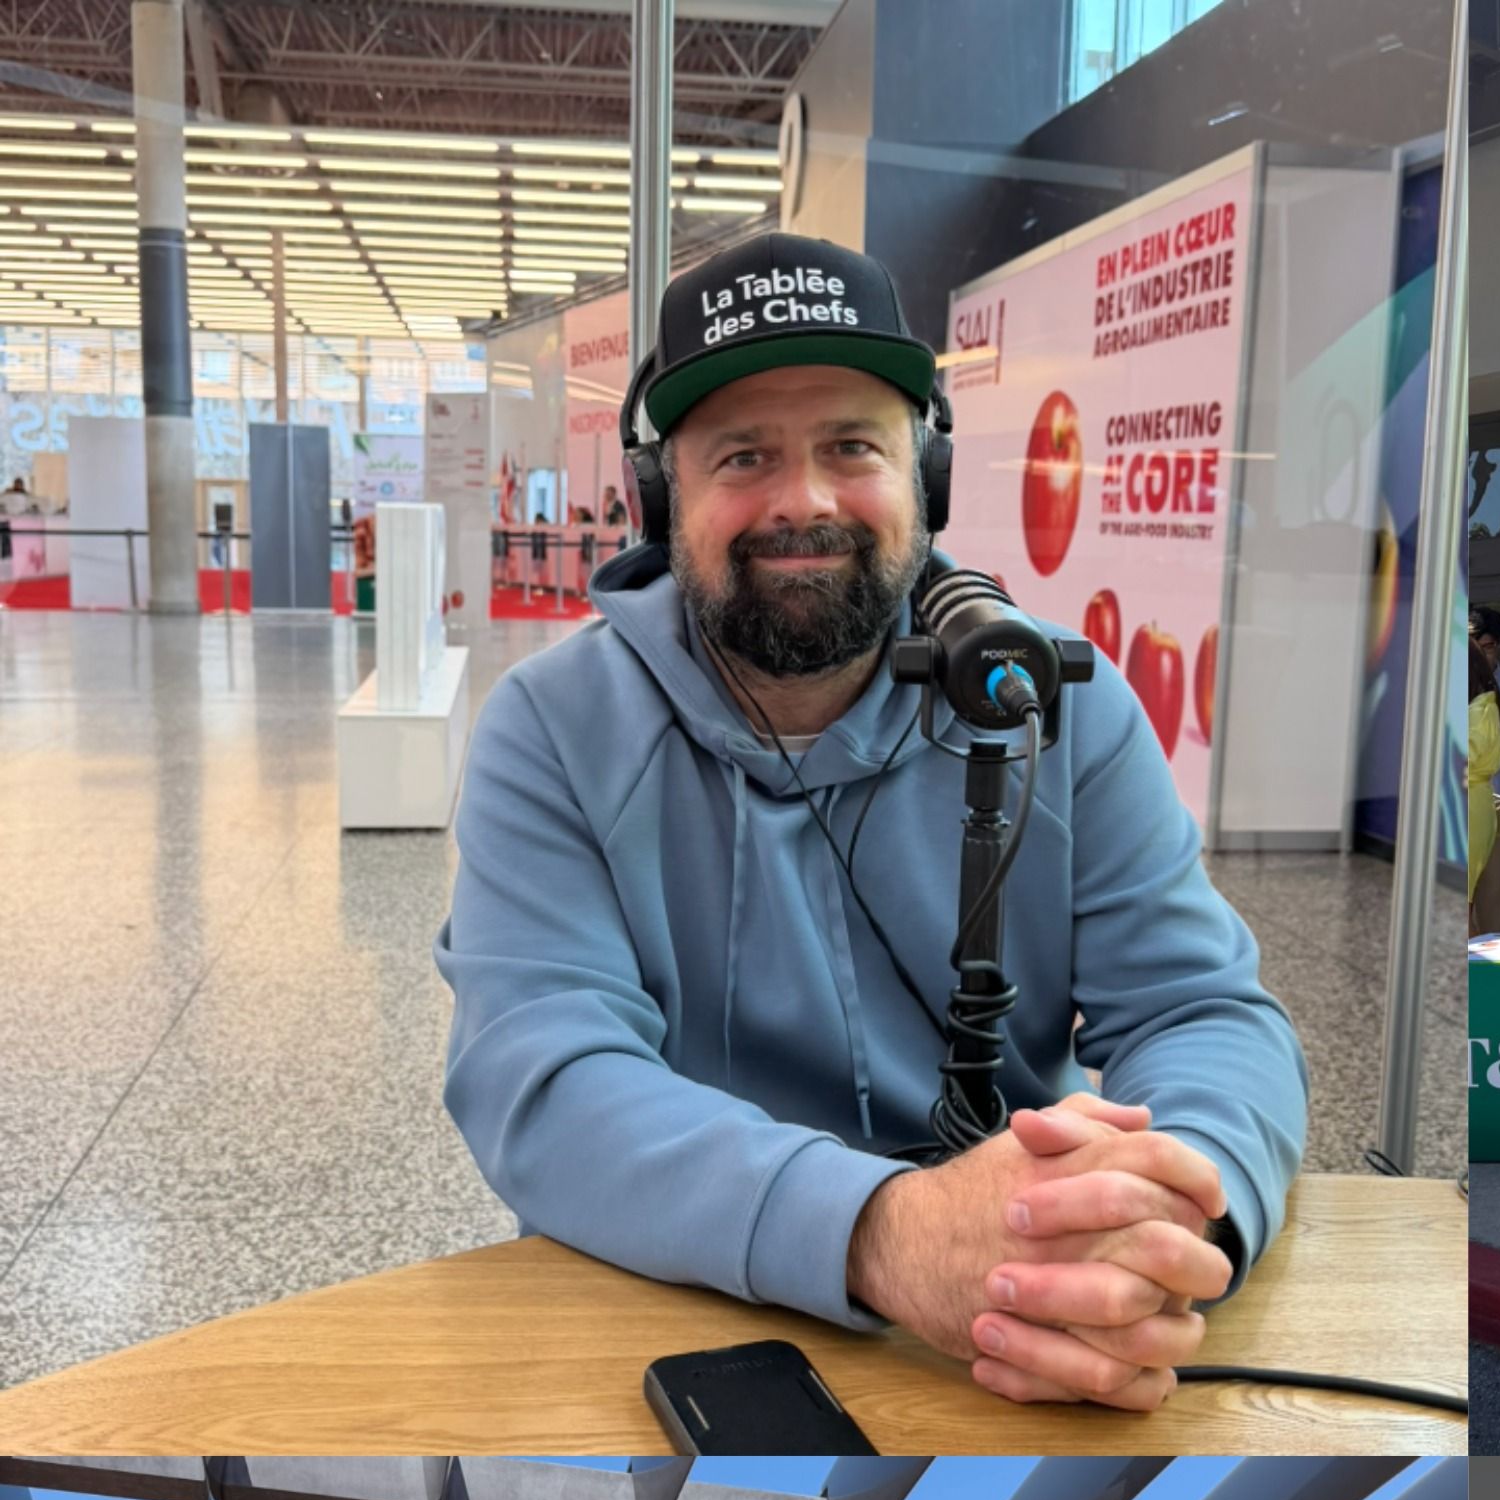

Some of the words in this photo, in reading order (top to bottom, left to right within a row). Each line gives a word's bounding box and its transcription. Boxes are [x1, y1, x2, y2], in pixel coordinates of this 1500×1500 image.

[1096, 250, 1118, 289] EN
[1120, 228, 1170, 279] PLEIN
[702, 288, 733, 317] La
[1094, 291, 1115, 327] DE
[1117, 249, 1234, 321] L'INDUSTRIE
[704, 311, 756, 345] des
[762, 298, 859, 326] Chefs
[1093, 297, 1231, 359] AGROALIMENTAIRE
[1105, 401, 1222, 446] CONNECTING
[1126, 448, 1219, 514] CORE
[981, 648, 1028, 660] PODMIC
